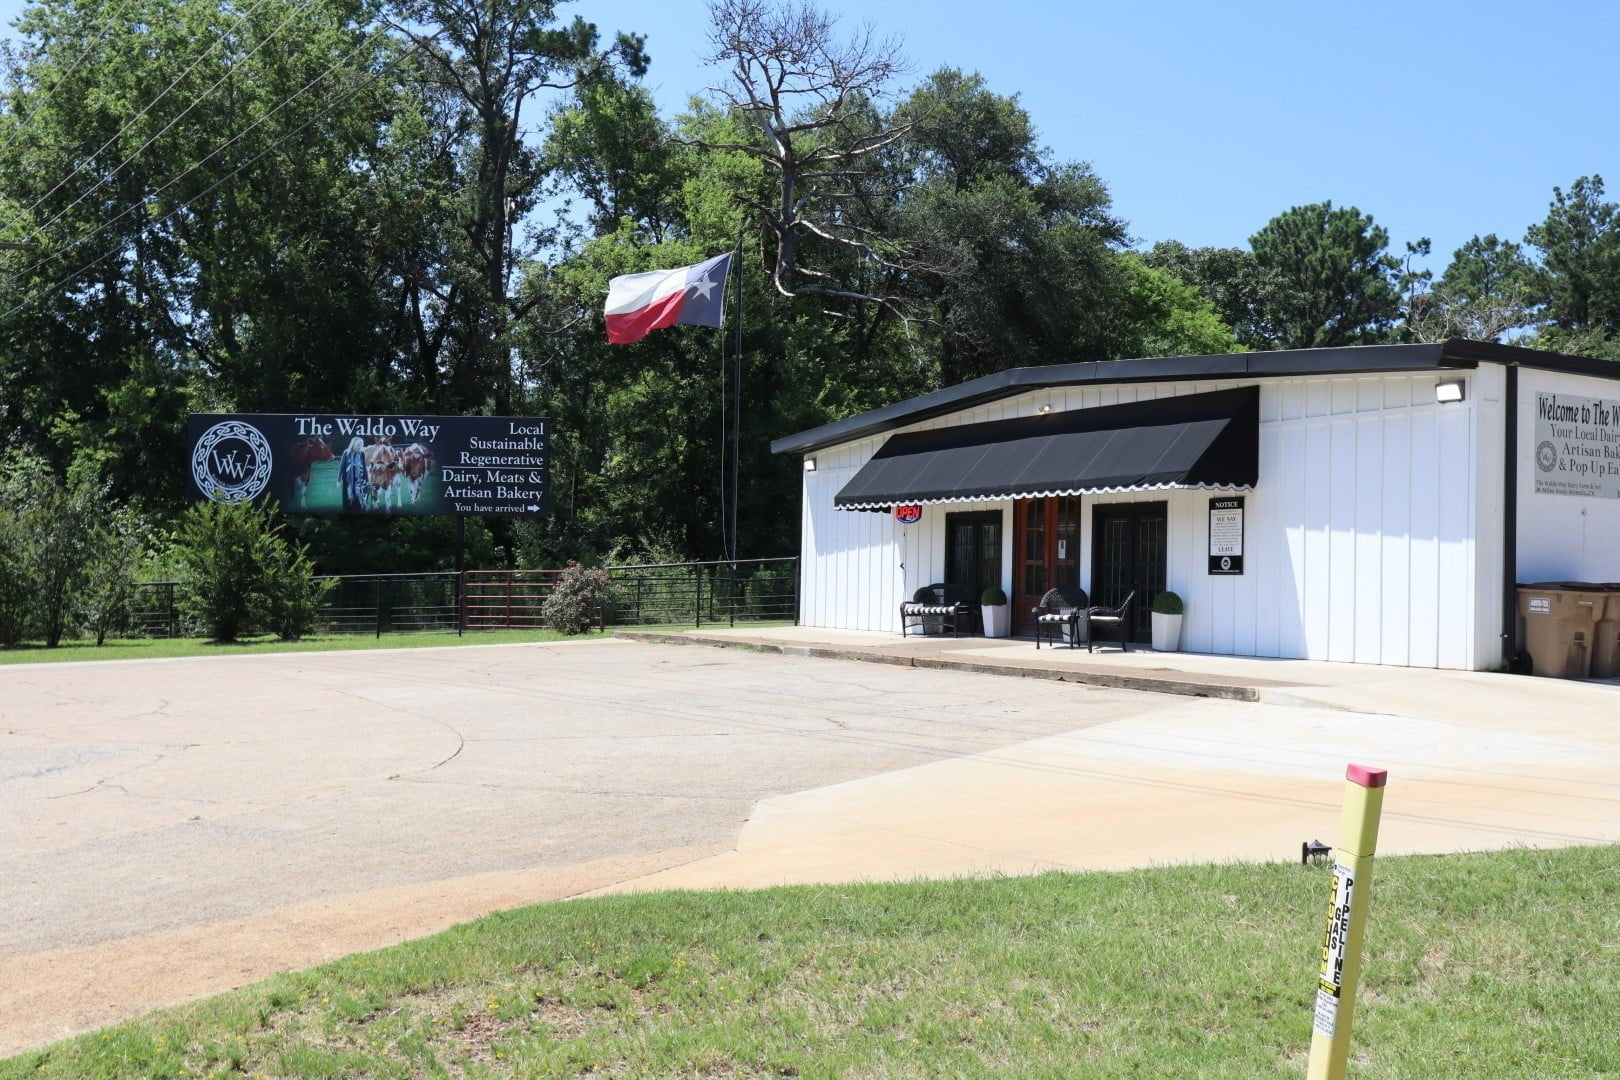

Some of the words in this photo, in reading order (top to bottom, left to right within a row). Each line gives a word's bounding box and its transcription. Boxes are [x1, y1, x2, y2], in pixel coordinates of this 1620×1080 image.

[1539, 395, 1579, 423] Welcome
[1581, 404, 1591, 425] to
[1593, 400, 1610, 427] The
[295, 416, 332, 436] The
[335, 417, 397, 436] Waldo
[399, 419, 440, 443] Way
[509, 422, 544, 435] Local
[1550, 424, 1573, 439] Your
[1575, 426, 1598, 441] Local
[470, 437, 544, 450] Sustainable
[1562, 442, 1601, 458] Artisan
[460, 451, 544, 467] Regenerative
[1558, 458, 1566, 471] &
[1570, 459, 1588, 476] Pop
[1591, 460, 1605, 477] Up
[442, 469, 482, 485] Dairy,
[486, 470, 525, 484] Meats
[528, 471, 543, 484] &
[443, 485, 492, 498] Artisan
[496, 485, 543, 501] Bakery
[455, 502, 472, 512] You
[474, 503, 493, 512] have
[495, 504, 525, 512] arrived
[896, 505, 919, 518] OPEN
[1320, 875, 1339, 976] CAUTION
[1331, 907, 1341, 949] GAS
[1333, 877, 1353, 985] PIPELINE
